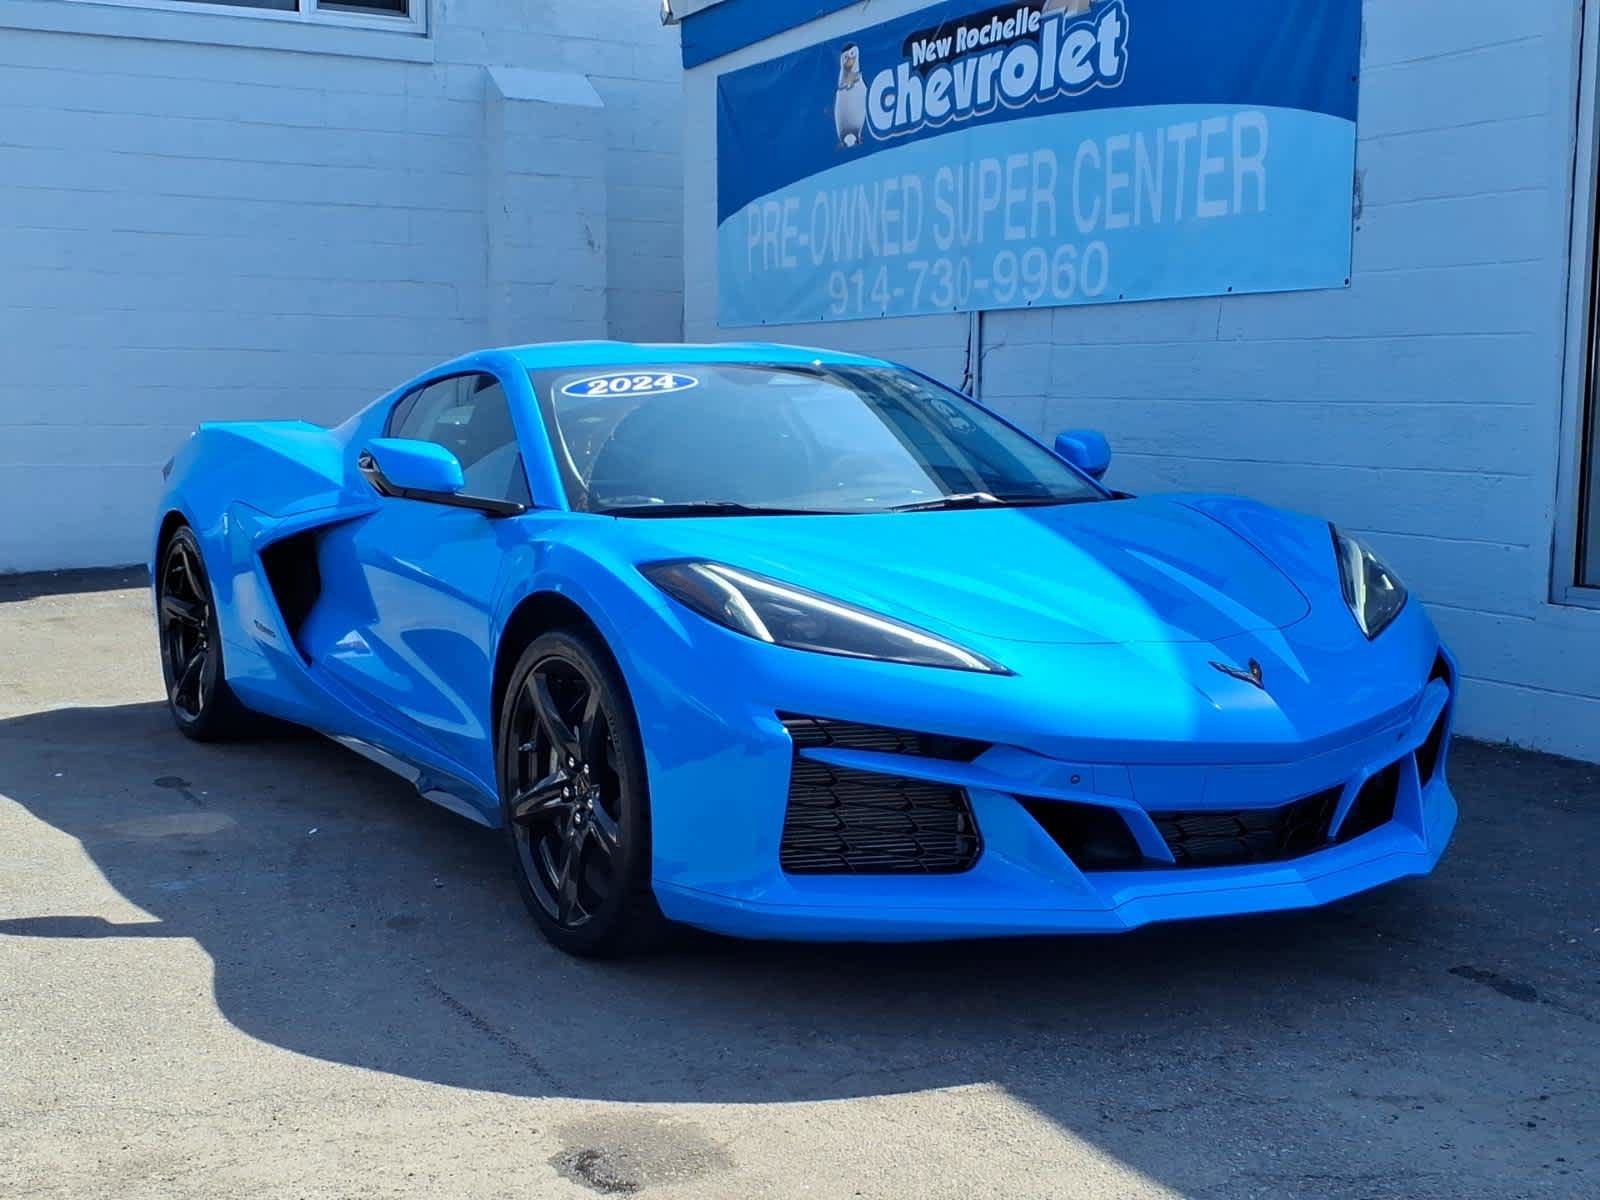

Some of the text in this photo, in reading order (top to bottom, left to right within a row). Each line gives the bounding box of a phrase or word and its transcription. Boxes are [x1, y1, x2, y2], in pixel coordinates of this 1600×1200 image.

[868, 8, 1121, 131] Chevrolet
[911, 6, 1041, 66] New Rochelle
[746, 110, 1269, 273] PRE-OWNED SUPER CENTER
[829, 240, 1109, 315] 914-730-9960
[587, 374, 677, 395] 2024
